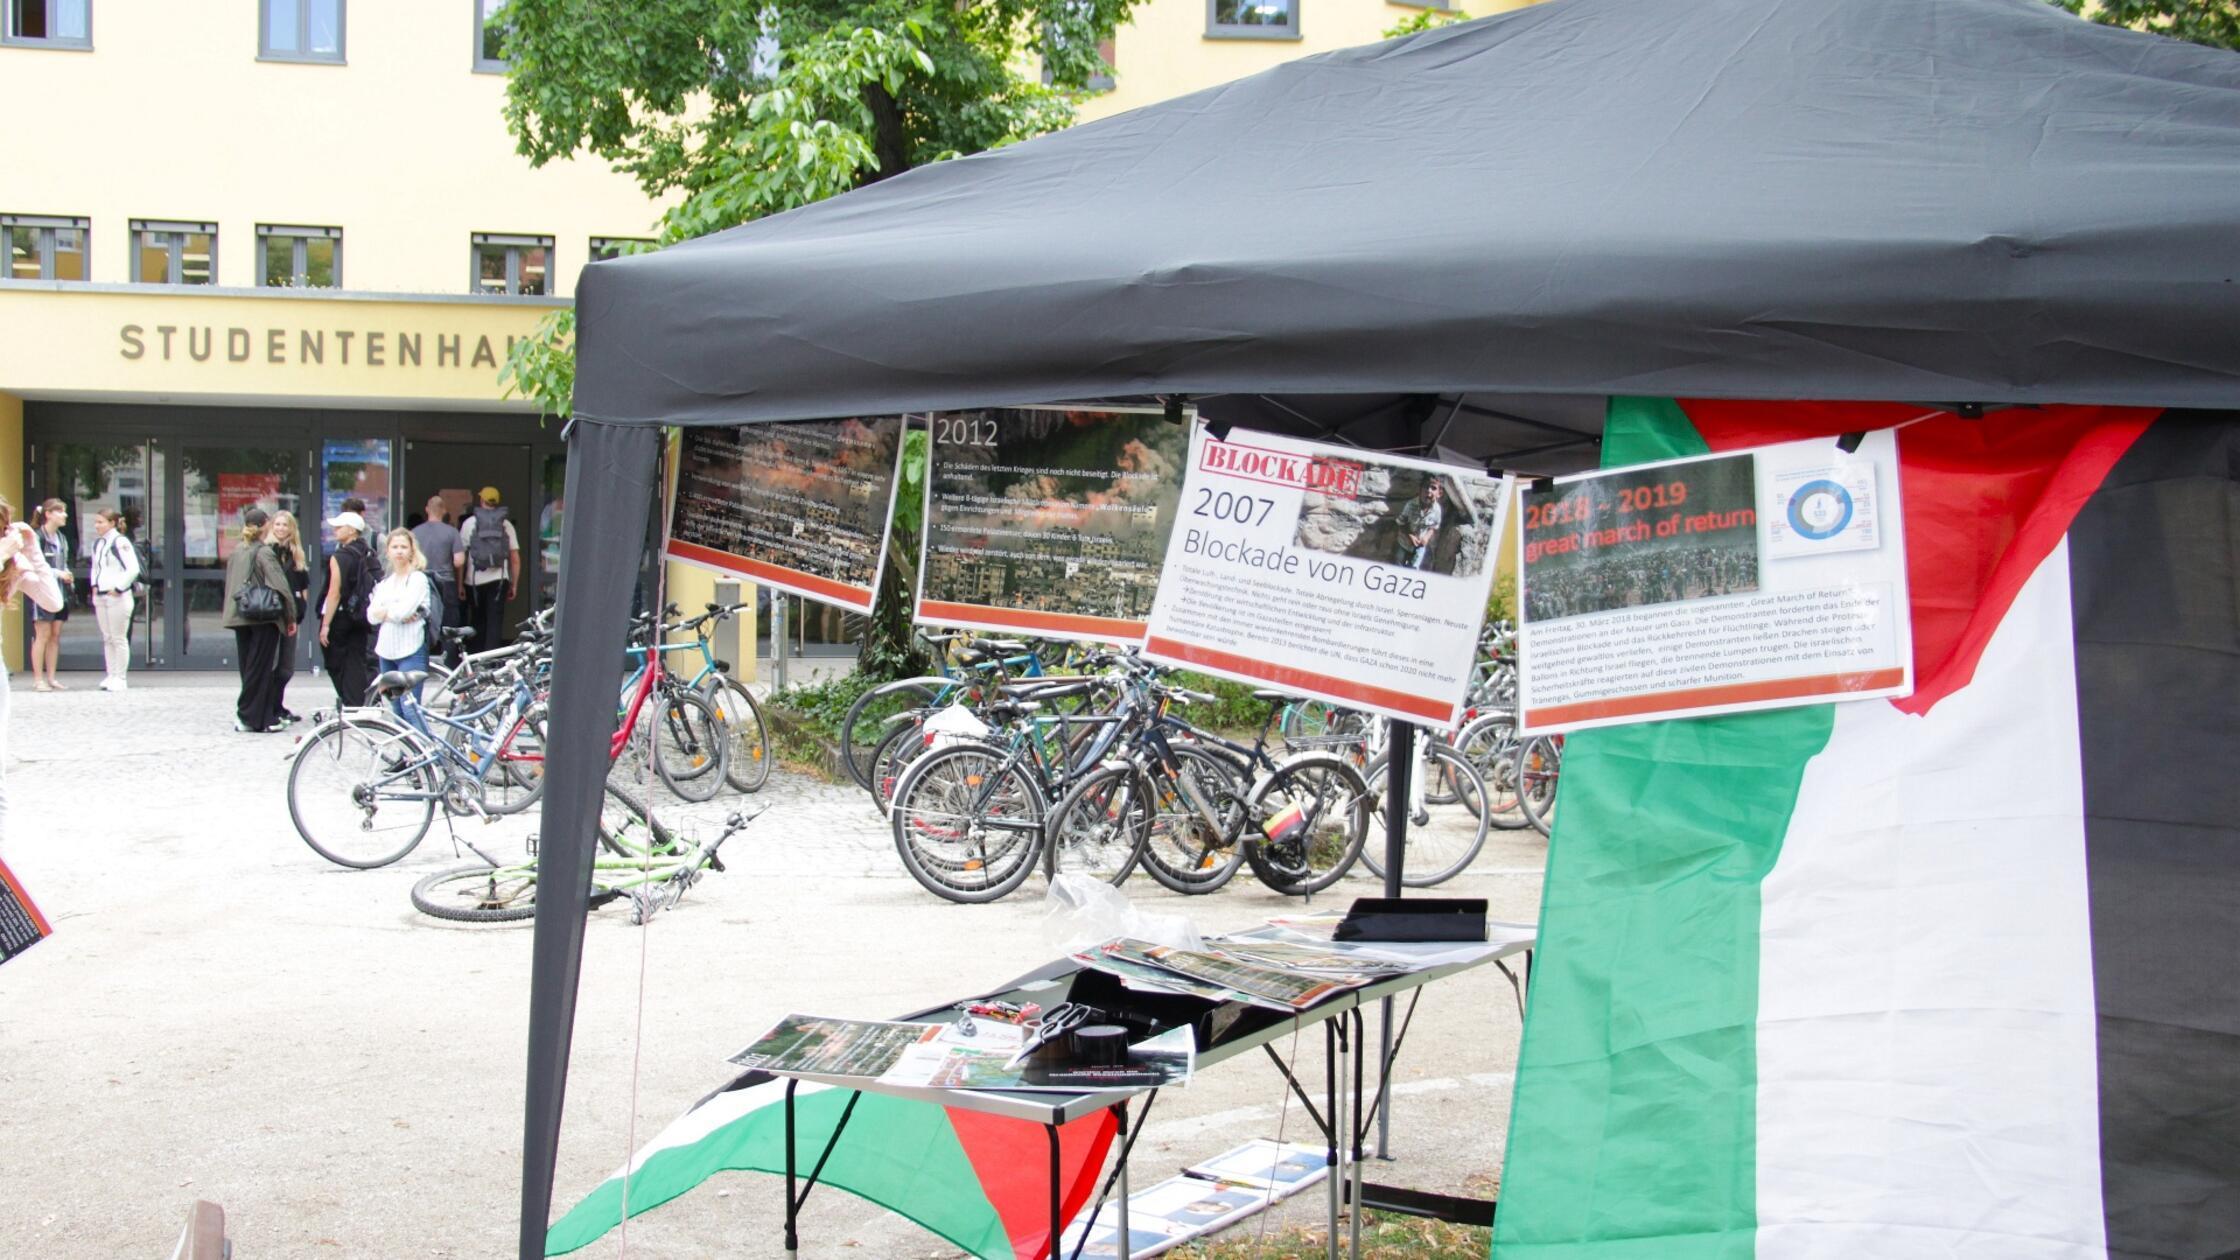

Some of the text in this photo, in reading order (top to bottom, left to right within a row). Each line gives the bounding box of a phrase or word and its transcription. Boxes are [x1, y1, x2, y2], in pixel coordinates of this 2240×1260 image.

[120, 323, 563, 368] STUDENTENHA
[936, 419, 1000, 446] 2012
[954, 462, 979, 470] Schäden
[1012, 465, 1034, 474] Krieges
[1205, 445, 1355, 492] BLOCKADE
[1192, 487, 1274, 528] 2007
[1526, 479, 1687, 529] 2018 2019
[1526, 532, 1578, 563] great
[1584, 517, 1650, 548] march
[1655, 512, 1682, 537] of
[1685, 505, 1755, 534] return
[1183, 528, 1429, 600] Blockade von Gaza
[1530, 632, 1596, 647] Demonstrationen
[1610, 627, 1623, 635] der
[1626, 624, 1651, 632] Mauer
[1695, 616, 1708, 624] Die
[1711, 608, 1776, 622] Demonstranten
[1779, 603, 1820, 614] forderten
[1865, 598, 1879, 606] der
[1590, 619, 1608, 627] März
[1611, 614, 1630, 624] 2018
[1633, 610, 1672, 621] begannen
[1690, 601, 1744, 614] sogenannten
[1777, 592, 1804, 603] March
[1531, 656, 1574, 669] weitgehend
[1577, 651, 1613, 664] gewaltlos
[1658, 643, 1682, 652] einige
[1685, 635, 1750, 648] Demonstranten
[1753, 631, 1778, 640] ließen
[1782, 627, 1818, 637] Drachen
[1820, 624, 1852, 633] steigen
[1576, 640, 1611, 651] Blockade
[1613, 636, 1629, 645] und
[1631, 635, 1644, 643] das
[1773, 615, 1813, 626] Während
[1816, 614, 1829, 622] die
[1359, 656, 1378, 666] GAZA
[1399, 664, 1417, 674] 2020
[1417, 669, 1436, 678] nicht
[1531, 677, 1594, 693] Sicherheitskräfte
[1597, 672, 1638, 683] reagierten
[1640, 669, 1653, 677] auf
[1655, 668, 1676, 676] diese
[1679, 664, 1705, 673] zivilen
[1708, 656, 1782, 670] Demonstrationen
[1784, 652, 1800, 661] mit
[1801, 651, 1821, 659] dem
[1569, 665, 1602, 675] Richtung
[1604, 660, 1626, 670] Israel
[1675, 650, 1720, 661] brennende
[1723, 647, 1756, 656] Lumpen
[1793, 639, 1808, 648] Die
[1573, 683, 1647, 698] Gummigeschossen
[1650, 679, 1665, 688] und
[1667, 676, 1702, 686] scharfer
[1704, 672, 1744, 682] Munition.
